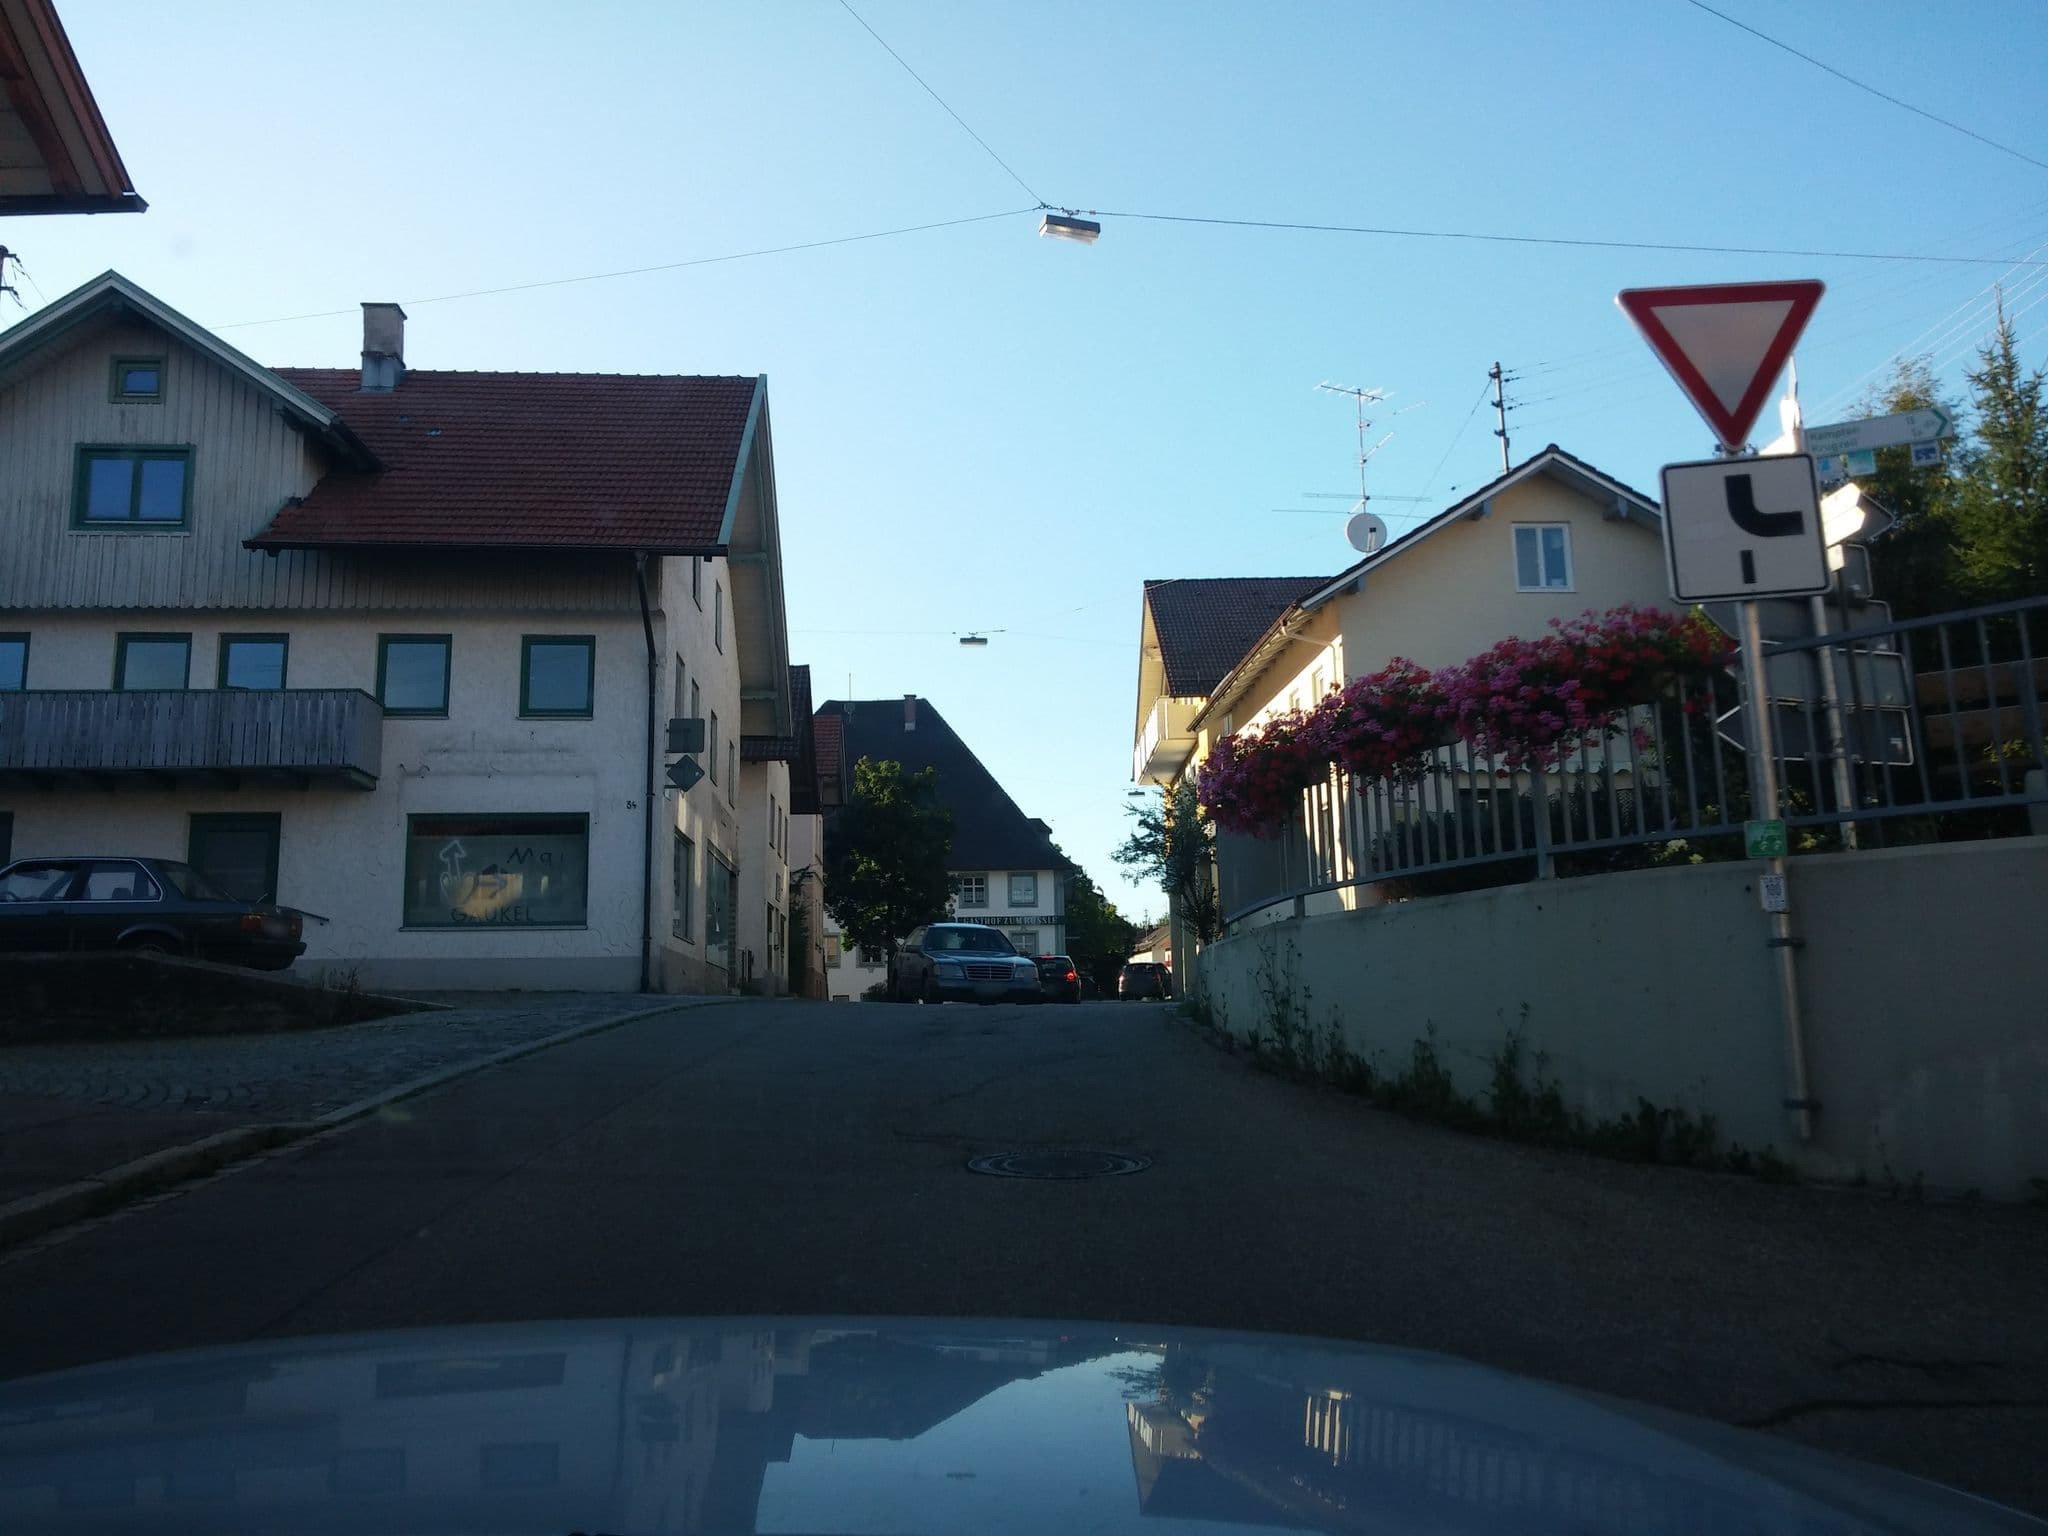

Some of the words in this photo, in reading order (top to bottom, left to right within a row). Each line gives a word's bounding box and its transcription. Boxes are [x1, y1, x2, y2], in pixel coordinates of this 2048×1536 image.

[451, 905, 534, 922] GAUKEL
[963, 917, 1002, 925] GASTHOF
[1003, 916, 1022, 924] ZUM
